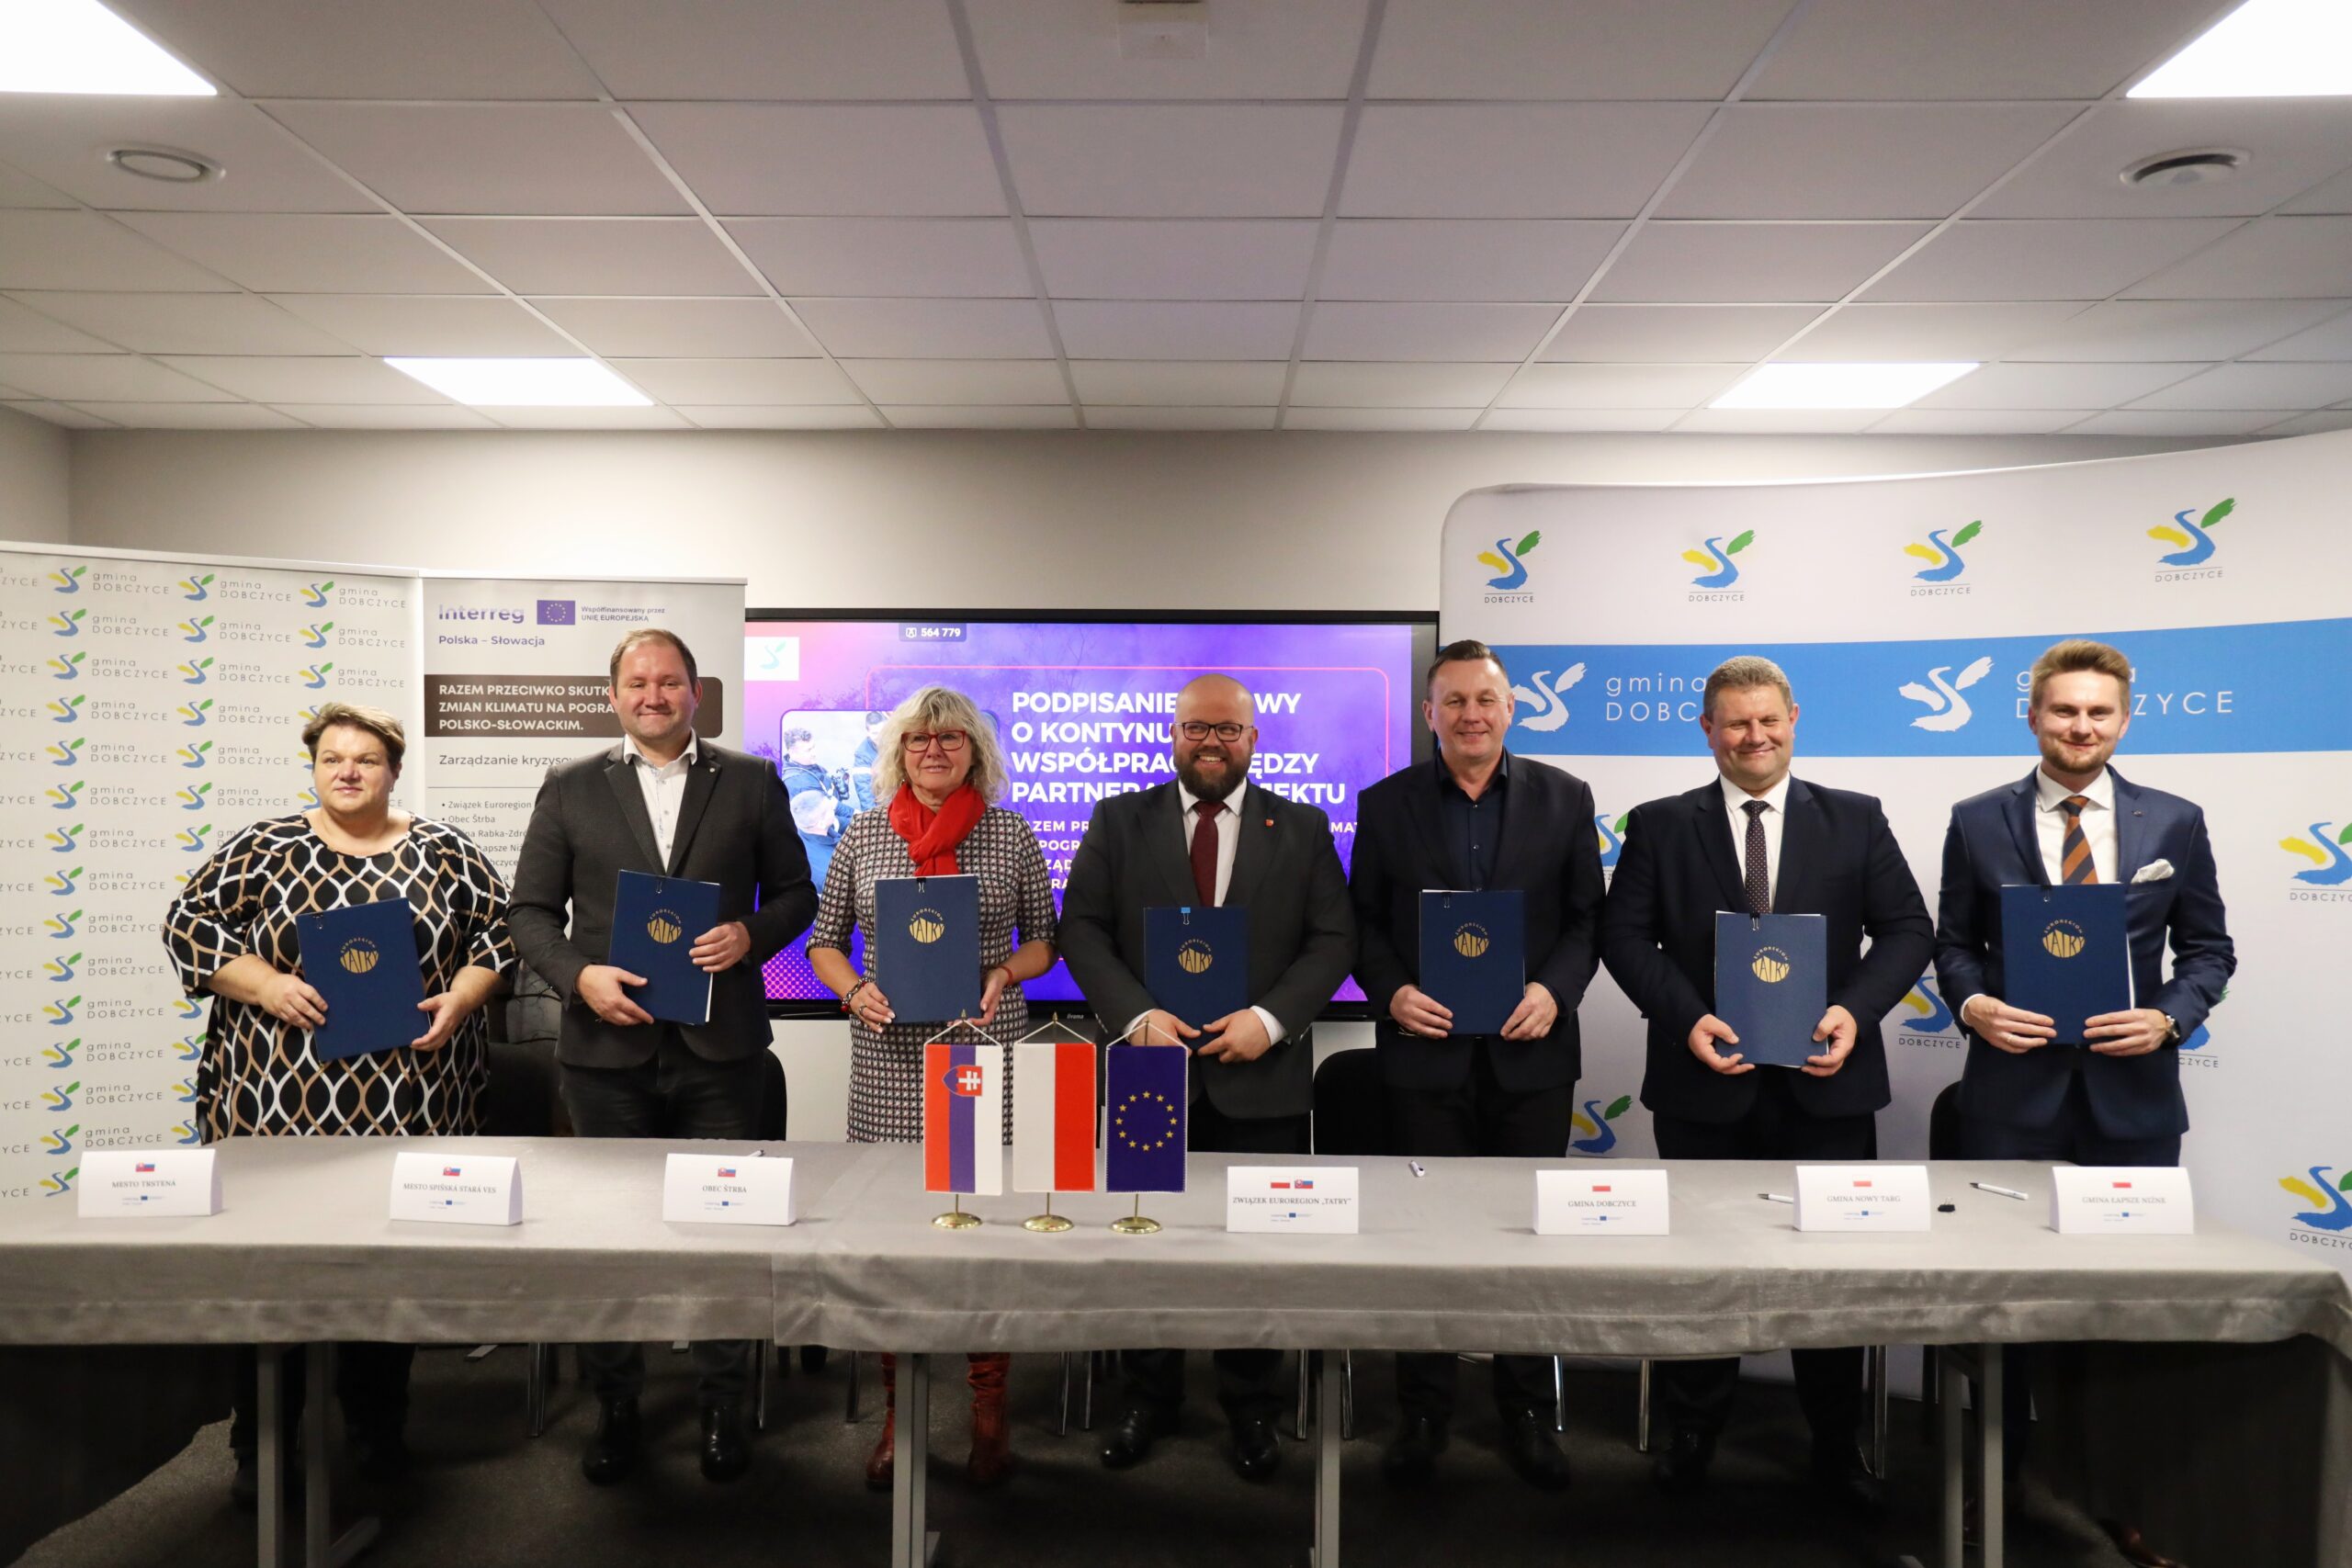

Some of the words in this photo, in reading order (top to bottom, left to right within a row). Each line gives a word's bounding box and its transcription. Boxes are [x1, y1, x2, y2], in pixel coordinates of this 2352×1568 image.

[93, 573, 136, 585] gmina
[2154, 570, 2224, 582] DOBCZYCE
[93, 581, 168, 594] DOBCZYCE
[220, 581, 263, 591] gmina
[220, 591, 290, 601] DOBCZYCE
[340, 589, 379, 597] gmina
[1910, 586, 1972, 597] DOBCZYCE
[340, 596, 405, 608] DOBCZYCE
[1484, 595, 1534, 604] DOBCZYCE
[1689, 594, 1745, 603] DOBCZYCE
[439, 604, 525, 625] Interreg
[93, 616, 136, 627] gmina
[93, 625, 167, 637] DOBCZYCE
[220, 623, 262, 632] gmina
[921, 627, 940, 637] 564
[941, 627, 961, 637] 779
[220, 632, 290, 642] DOBCZYCE
[339, 629, 379, 637] gmina
[339, 637, 404, 648] DOBCZYCE
[438, 635, 478, 645] Polska
[491, 635, 546, 648] Słowacja
[92, 660, 135, 670] gmina
[220, 664, 261, 673] gmina
[92, 667, 167, 678] DOBCZYCE
[220, 673, 289, 682] DOBCZYCE
[338, 669, 378, 678] gmina
[338, 677, 404, 687] DOBCZYCE
[1606, 672, 1707, 697] gmina
[439, 684, 484, 695] RAZEM
[487, 684, 565, 696] PRZECIWKO
[568, 685, 610, 696] SKUTK
[92, 702, 135, 713] gmina
[439, 702, 481, 713] ZMIAN
[485, 702, 543, 713] KLIMATU
[547, 703, 565, 713] NA
[569, 703, 617, 714] POGRA
[1012, 692, 1179, 714] PODPISANIE
[92, 710, 166, 720] DOBCZYCE
[219, 705, 260, 715] gmina
[1606, 702, 1698, 722] DOBC
[219, 715, 289, 724] DOBCZYCE
[439, 718, 584, 730] POLSKO-SŁOWACKIM.
[1011, 721, 1034, 743] O
[1041, 722, 1173, 743] KONTYNU
[91, 745, 134, 755] gmina
[219, 747, 259, 756] gmina
[91, 752, 166, 762] DOBCZYCE
[219, 756, 289, 764] DOBCZYCE
[439, 753, 519, 767] Zarządzanie
[522, 754, 572, 767] kryzyso
[1247, 752, 1319, 780] ĘDZY
[90, 787, 134, 795] gmina
[218, 789, 258, 798] gmina
[91, 795, 165, 805] DOBCZYCE
[447, 801, 481, 810] Związek
[484, 801, 532, 810] Euroregion
[472, 814, 496, 823] Štrba
[1026, 820, 1066, 832] ZEM
[90, 830, 133, 840] gmina
[90, 838, 165, 847] DOBCZYCE
[89, 874, 132, 883] gmina
[89, 881, 164, 890] DOBCZYCE
[89, 915, 132, 926] gmina
[88, 957, 131, 968] gmina
[88, 965, 164, 976] DOBCZYCE
[88, 1000, 131, 1010] gmina
[87, 1007, 163, 1019] DOBCZYCE
[1898, 1037, 1961, 1048] DOBCZYCE
[87, 1043, 130, 1054] gmina
[87, 1049, 162, 1061] DOBCZYCE
[2178, 1057, 2219, 1068] CZYCE
[86, 1085, 130, 1096] gmina
[86, 1091, 162, 1104] DOBCZYCE
[85, 1127, 130, 1139] gmina
[85, 1134, 161, 1147] DOBCZYCE
[111, 1179, 140, 1189] MESTO
[402, 1182, 428, 1191] MESTO
[483, 1186, 496, 1194] VES
[723, 1184, 748, 1193] ŠTRBA
[1232, 1197, 1268, 1206] ZWIĄZEK
[1269, 1197, 1320, 1205] EUROREGION
[1567, 1200, 1595, 1208] GMINA
[1596, 1200, 1637, 1208] DOBCZYCE
